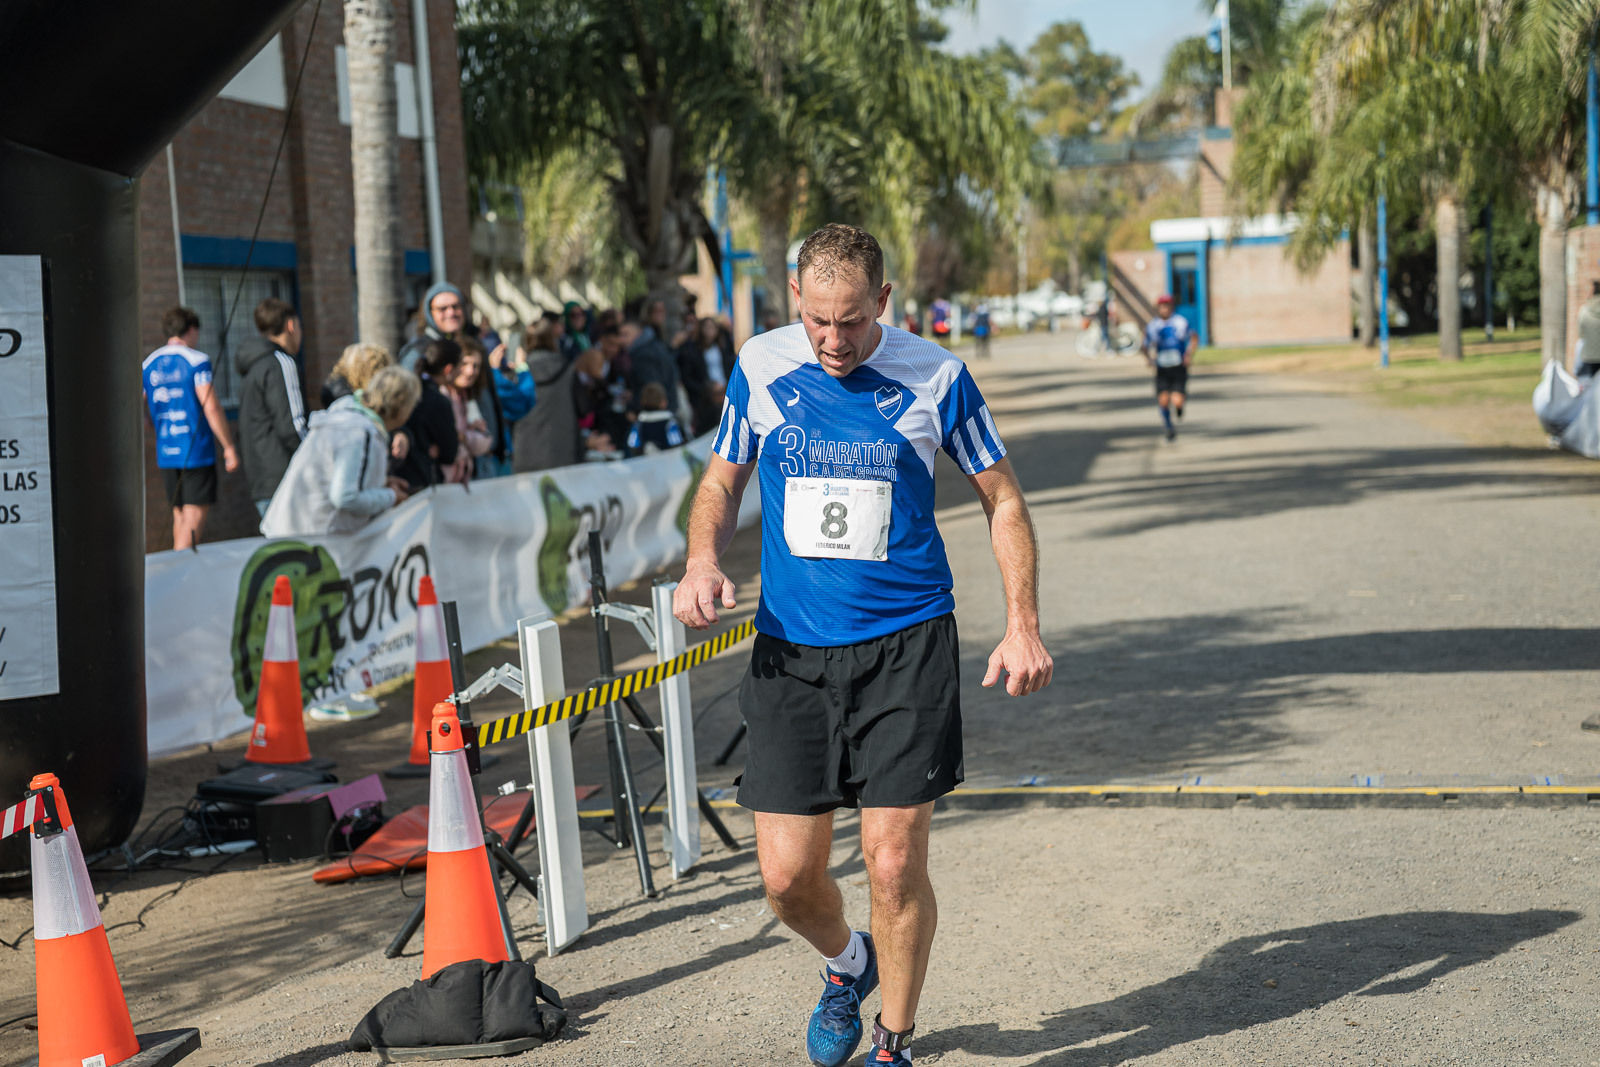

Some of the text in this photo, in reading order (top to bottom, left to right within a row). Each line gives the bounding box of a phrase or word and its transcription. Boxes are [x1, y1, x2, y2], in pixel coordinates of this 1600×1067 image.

[778, 425, 806, 478] 3
[809, 439, 898, 467] MARATÓN
[3, 471, 38, 491] LAS
[820, 501, 849, 539] 8
